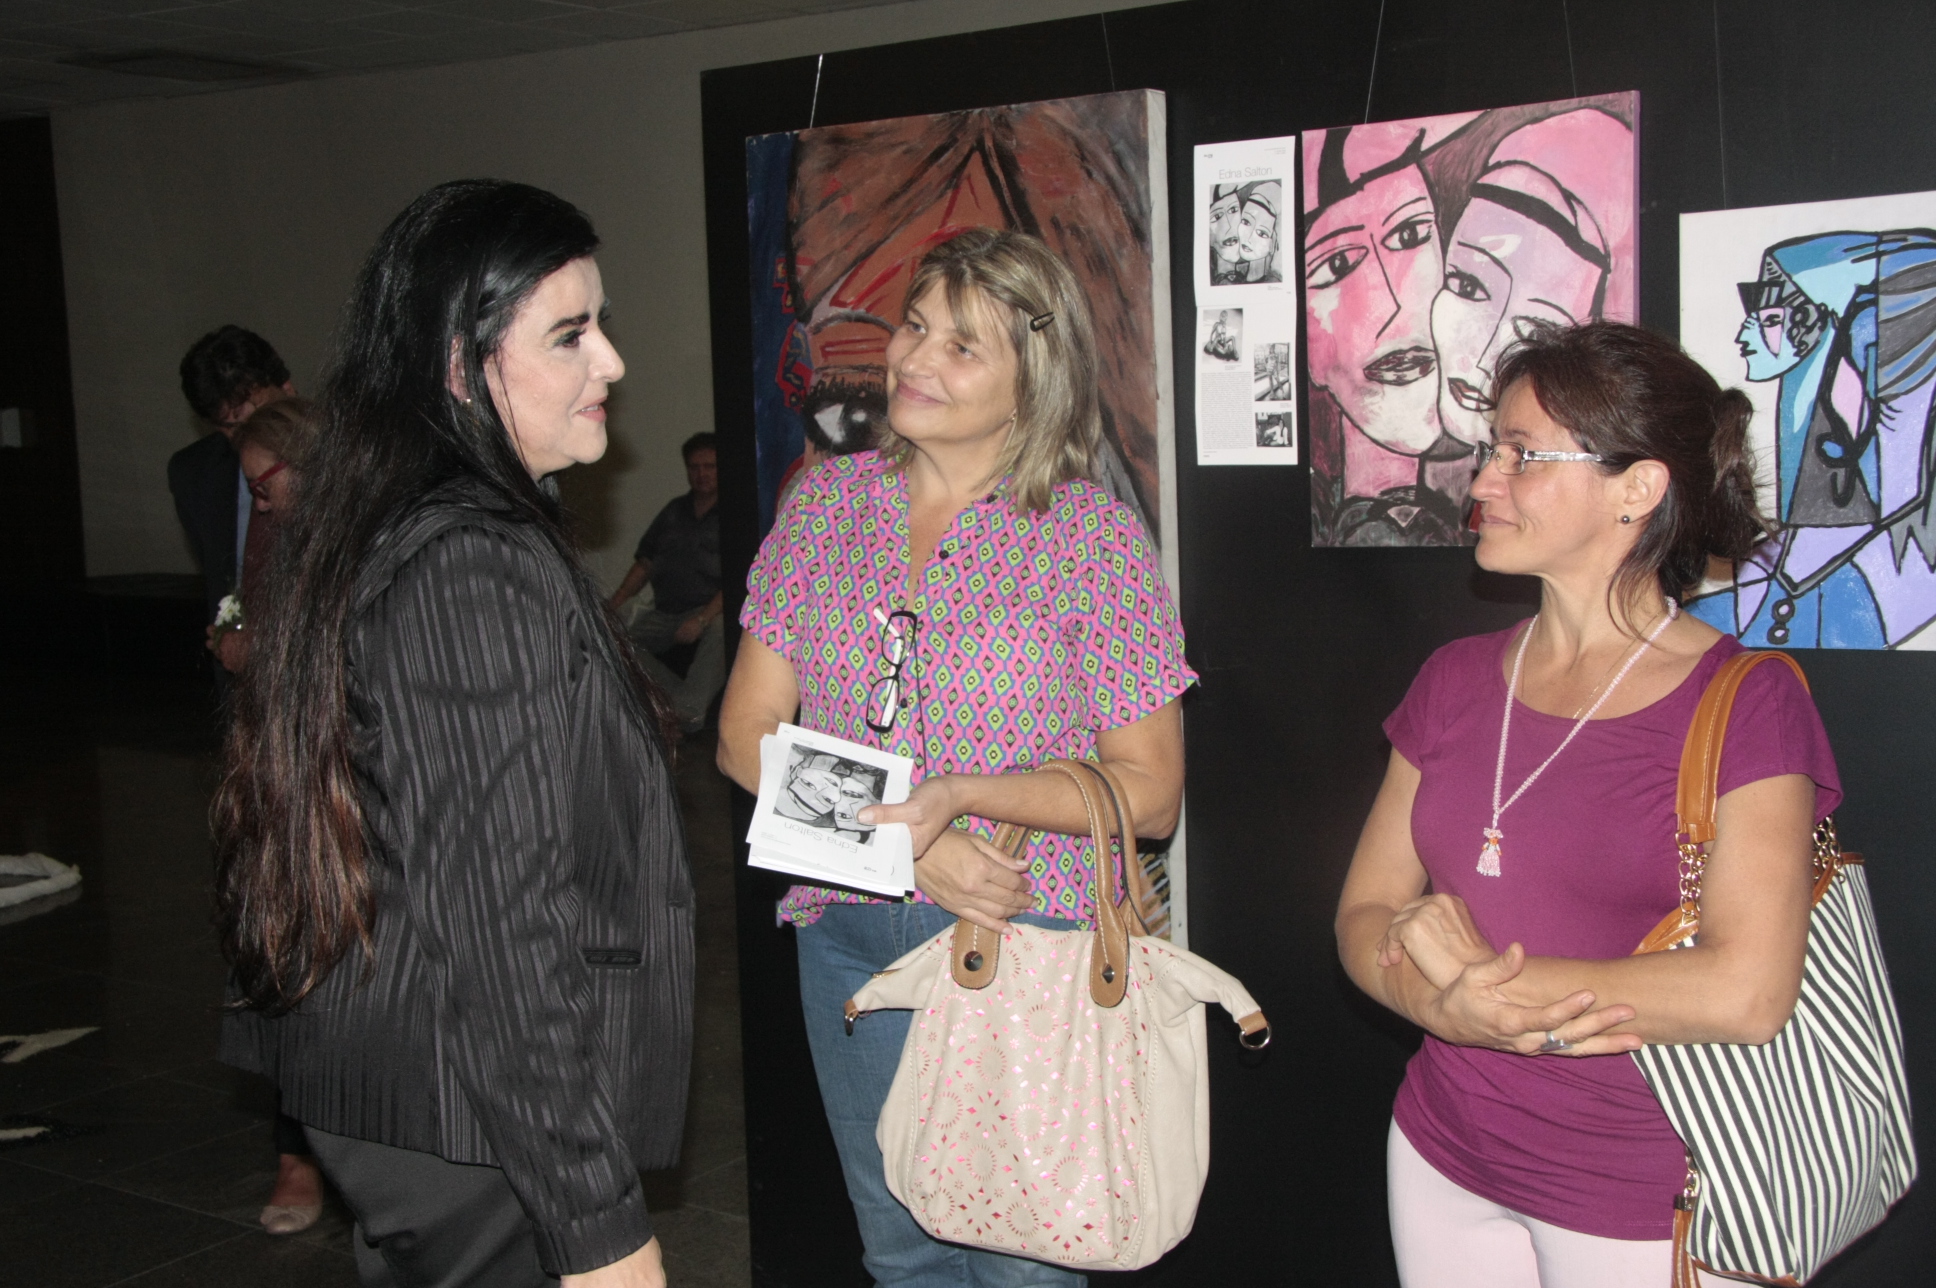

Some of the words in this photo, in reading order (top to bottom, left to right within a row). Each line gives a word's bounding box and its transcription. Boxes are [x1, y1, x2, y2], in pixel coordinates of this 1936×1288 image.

[1218, 169, 1242, 180] Edna
[1244, 166, 1273, 178] Salton
[784, 821, 823, 841] Salton
[826, 836, 858, 854] Edna
